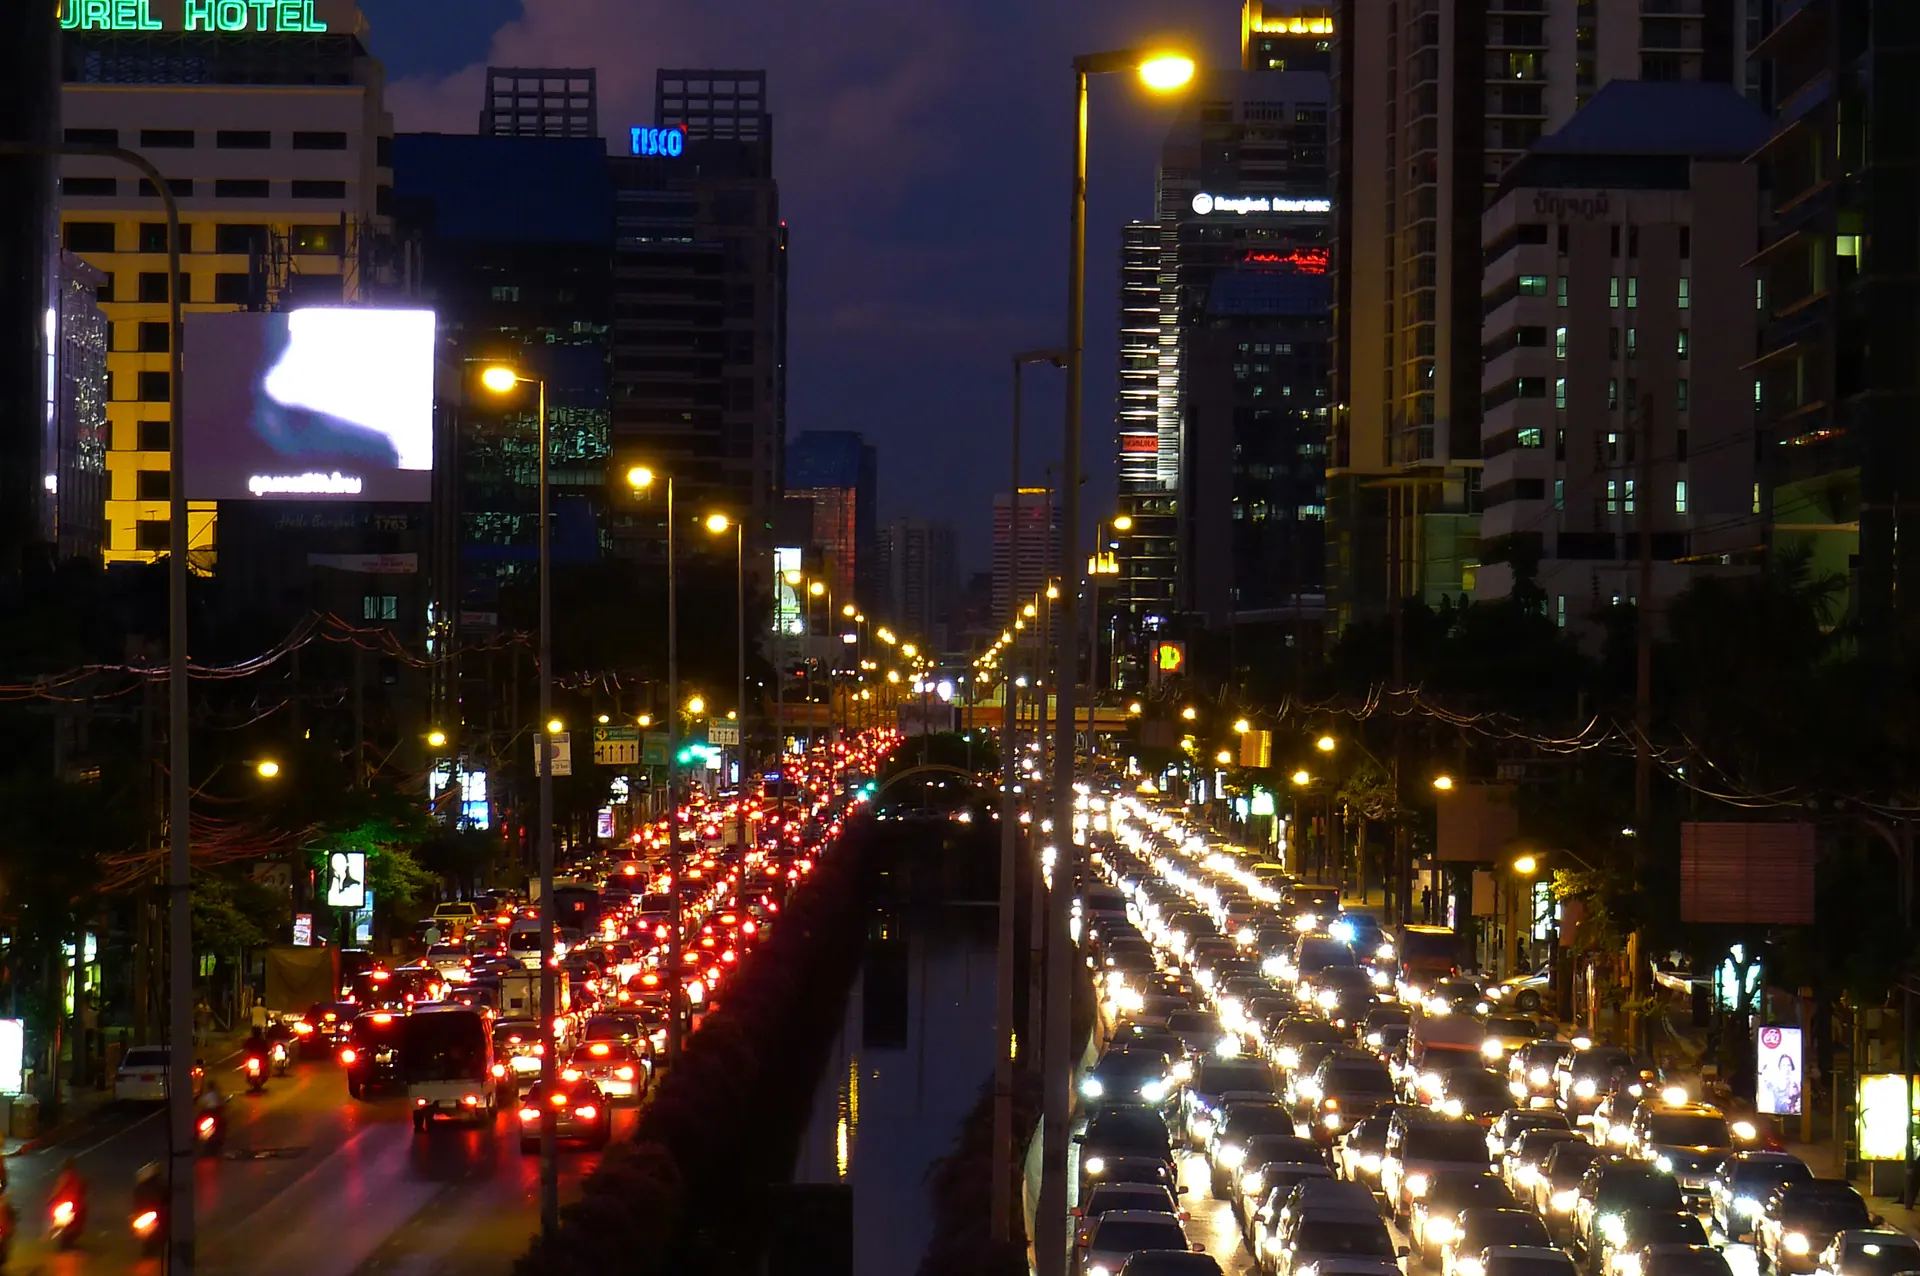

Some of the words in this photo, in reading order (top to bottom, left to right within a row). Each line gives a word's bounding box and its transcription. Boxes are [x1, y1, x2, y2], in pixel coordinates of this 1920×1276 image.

[184, 0, 327, 32] HOTEL
[631, 127, 682, 156] TISCO
[374, 519, 408, 532] 1763
